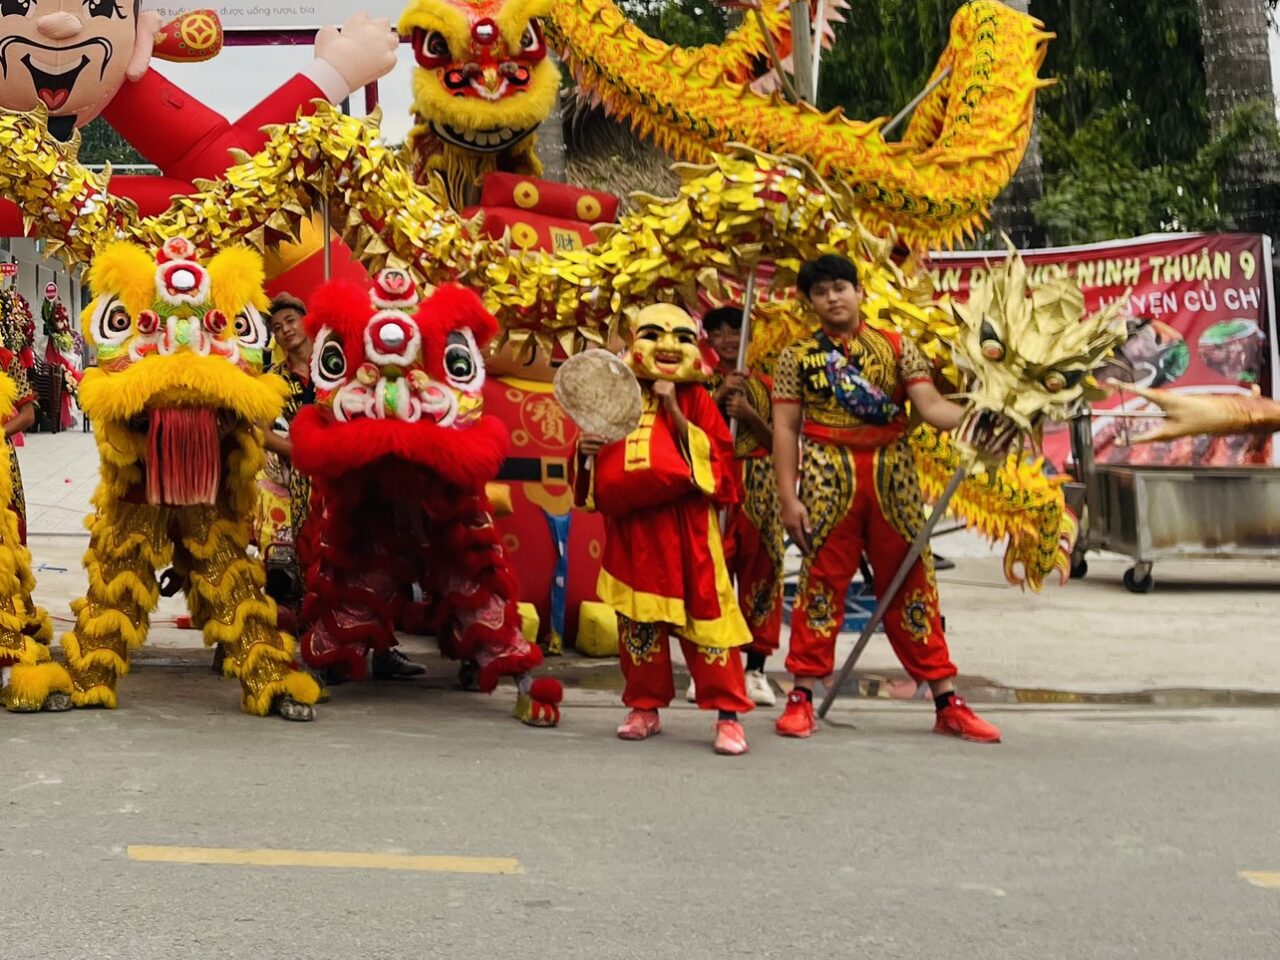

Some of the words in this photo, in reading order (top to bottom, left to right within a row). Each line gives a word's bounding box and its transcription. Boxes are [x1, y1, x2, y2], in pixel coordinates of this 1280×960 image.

[299, 5, 315, 15] bia
[1077, 256, 1141, 289] NINH
[1239, 249, 1257, 281] 9
